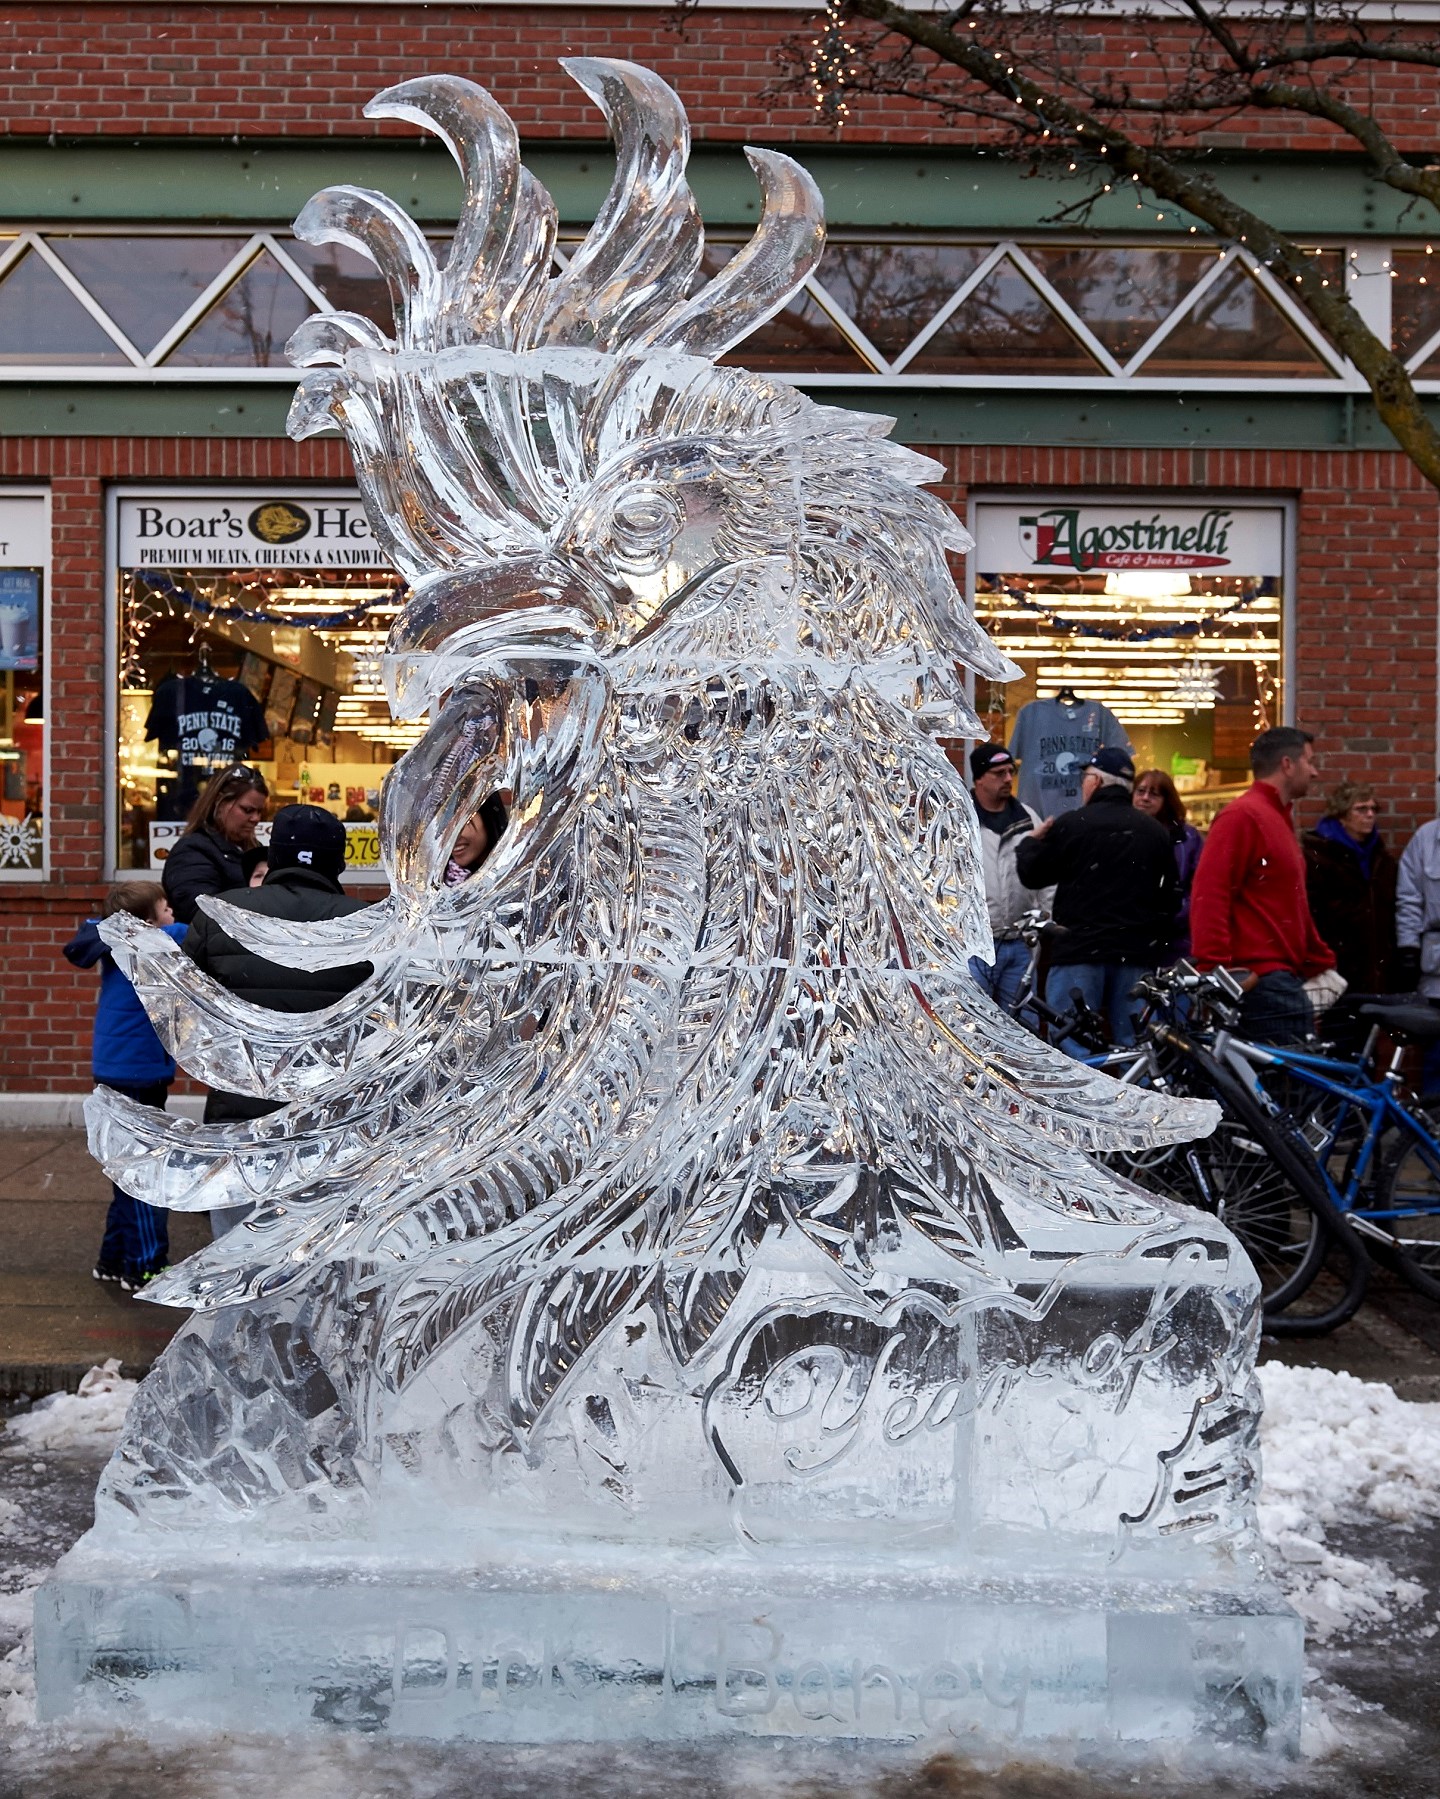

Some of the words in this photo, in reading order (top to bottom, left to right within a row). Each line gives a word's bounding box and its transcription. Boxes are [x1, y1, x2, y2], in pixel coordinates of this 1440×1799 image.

[136, 507, 243, 538] Boar's
[313, 508, 375, 538] He
[1033, 509, 1233, 572] Agostinelli
[140, 549, 202, 564] PREMIUM
[255, 549, 310, 564] CHEESES
[314, 550, 323, 564] &
[1143, 554, 1172, 567] Juice
[1174, 555, 1196, 566] Bar
[177, 711, 209, 737] PENN
[209, 711, 242, 738] STATE
[182, 737, 199, 751] 20
[221, 738, 235, 751] 16
[1040, 735, 1067, 759] PENN
